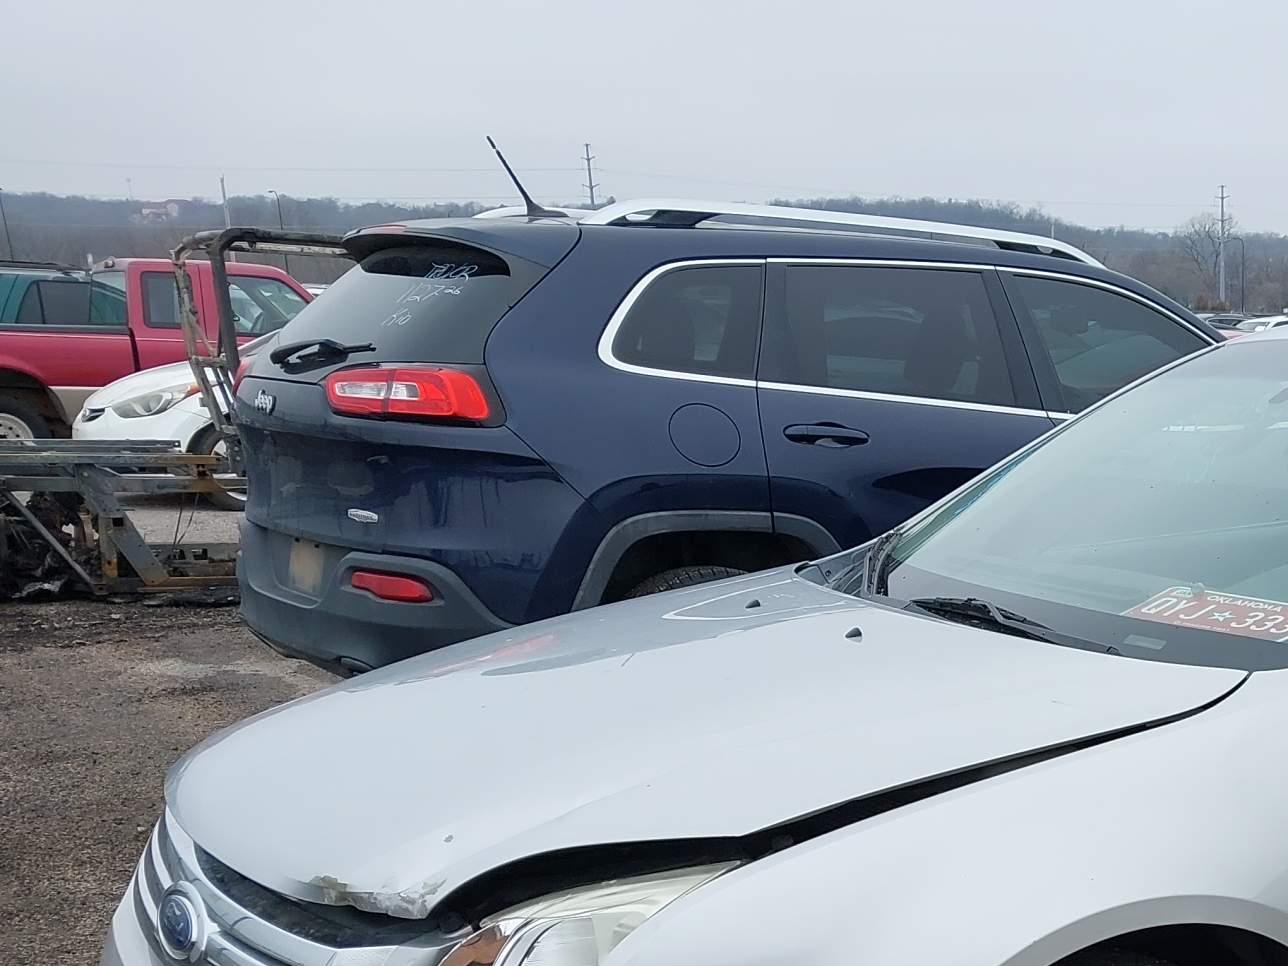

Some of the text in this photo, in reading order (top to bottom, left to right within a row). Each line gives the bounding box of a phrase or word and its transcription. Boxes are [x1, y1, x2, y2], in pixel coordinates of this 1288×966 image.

[254, 389, 273, 414] Jeep
[1141, 596, 1217, 621] QYJ
[1206, 594, 1282, 612] OKLAHOMA
